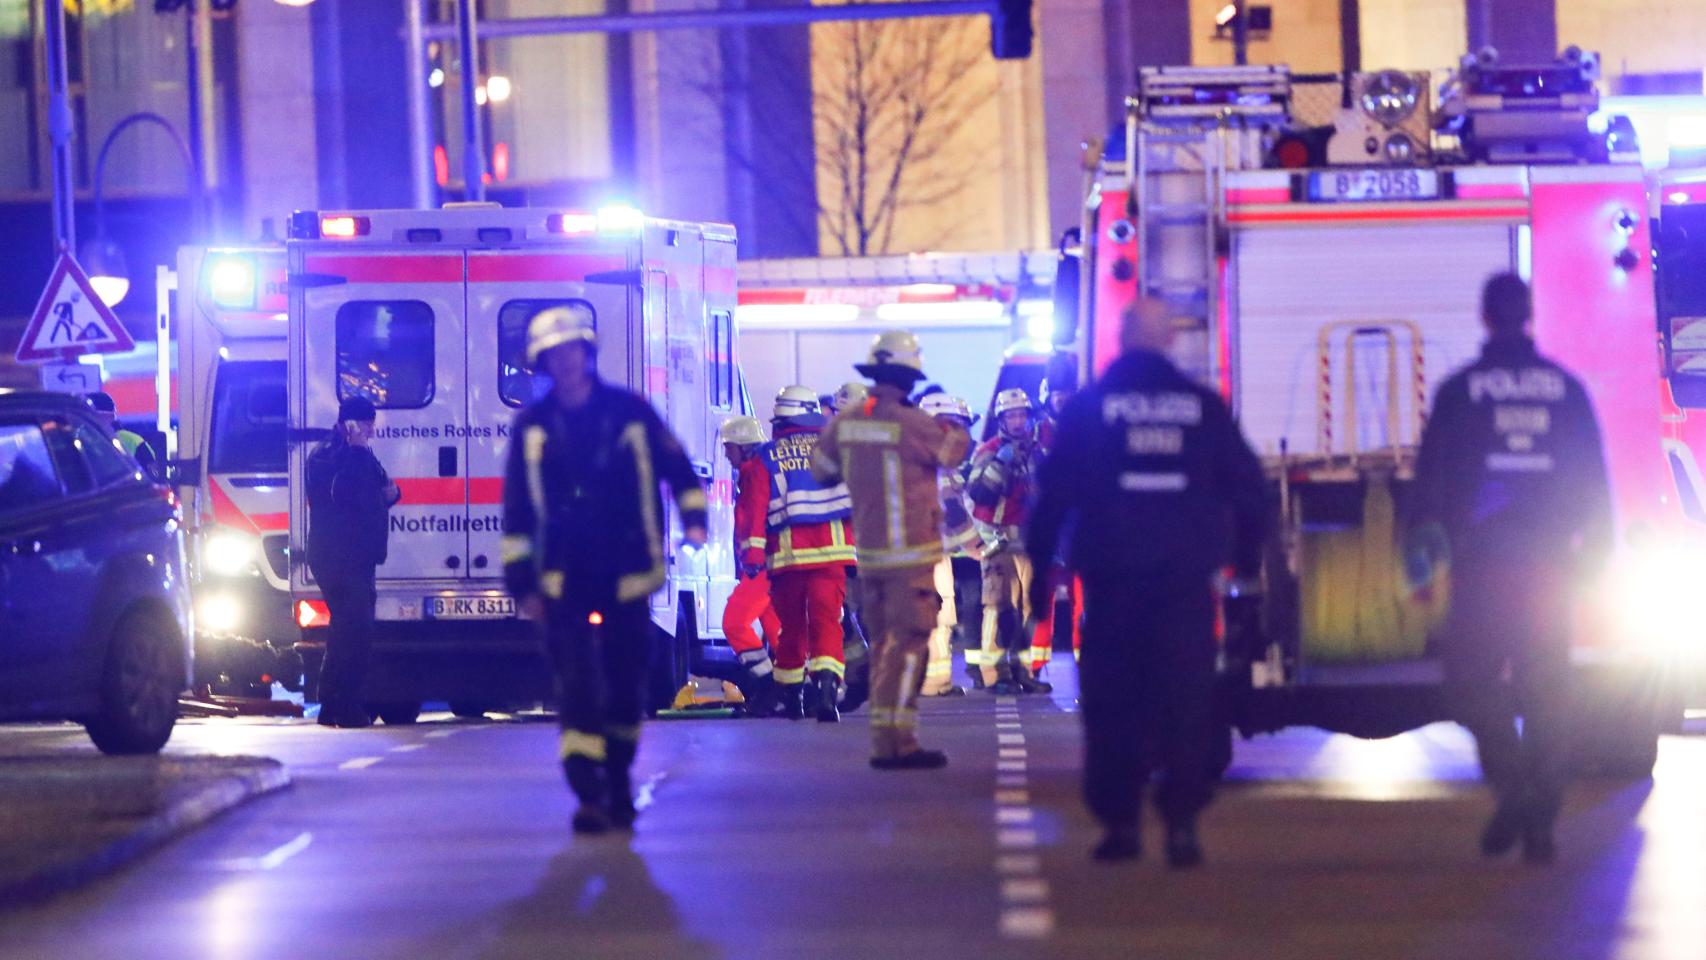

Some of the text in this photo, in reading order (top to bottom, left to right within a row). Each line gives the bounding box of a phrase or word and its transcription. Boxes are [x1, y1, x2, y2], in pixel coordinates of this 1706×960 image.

[1335, 170, 1419, 195] B 2058
[375, 425, 438, 438] utsches
[444, 424, 491, 438] Rotes
[778, 457, 812, 473] NOTA
[390, 515, 505, 532] Notfallrett
[434, 599, 514, 614] B RK 8311
